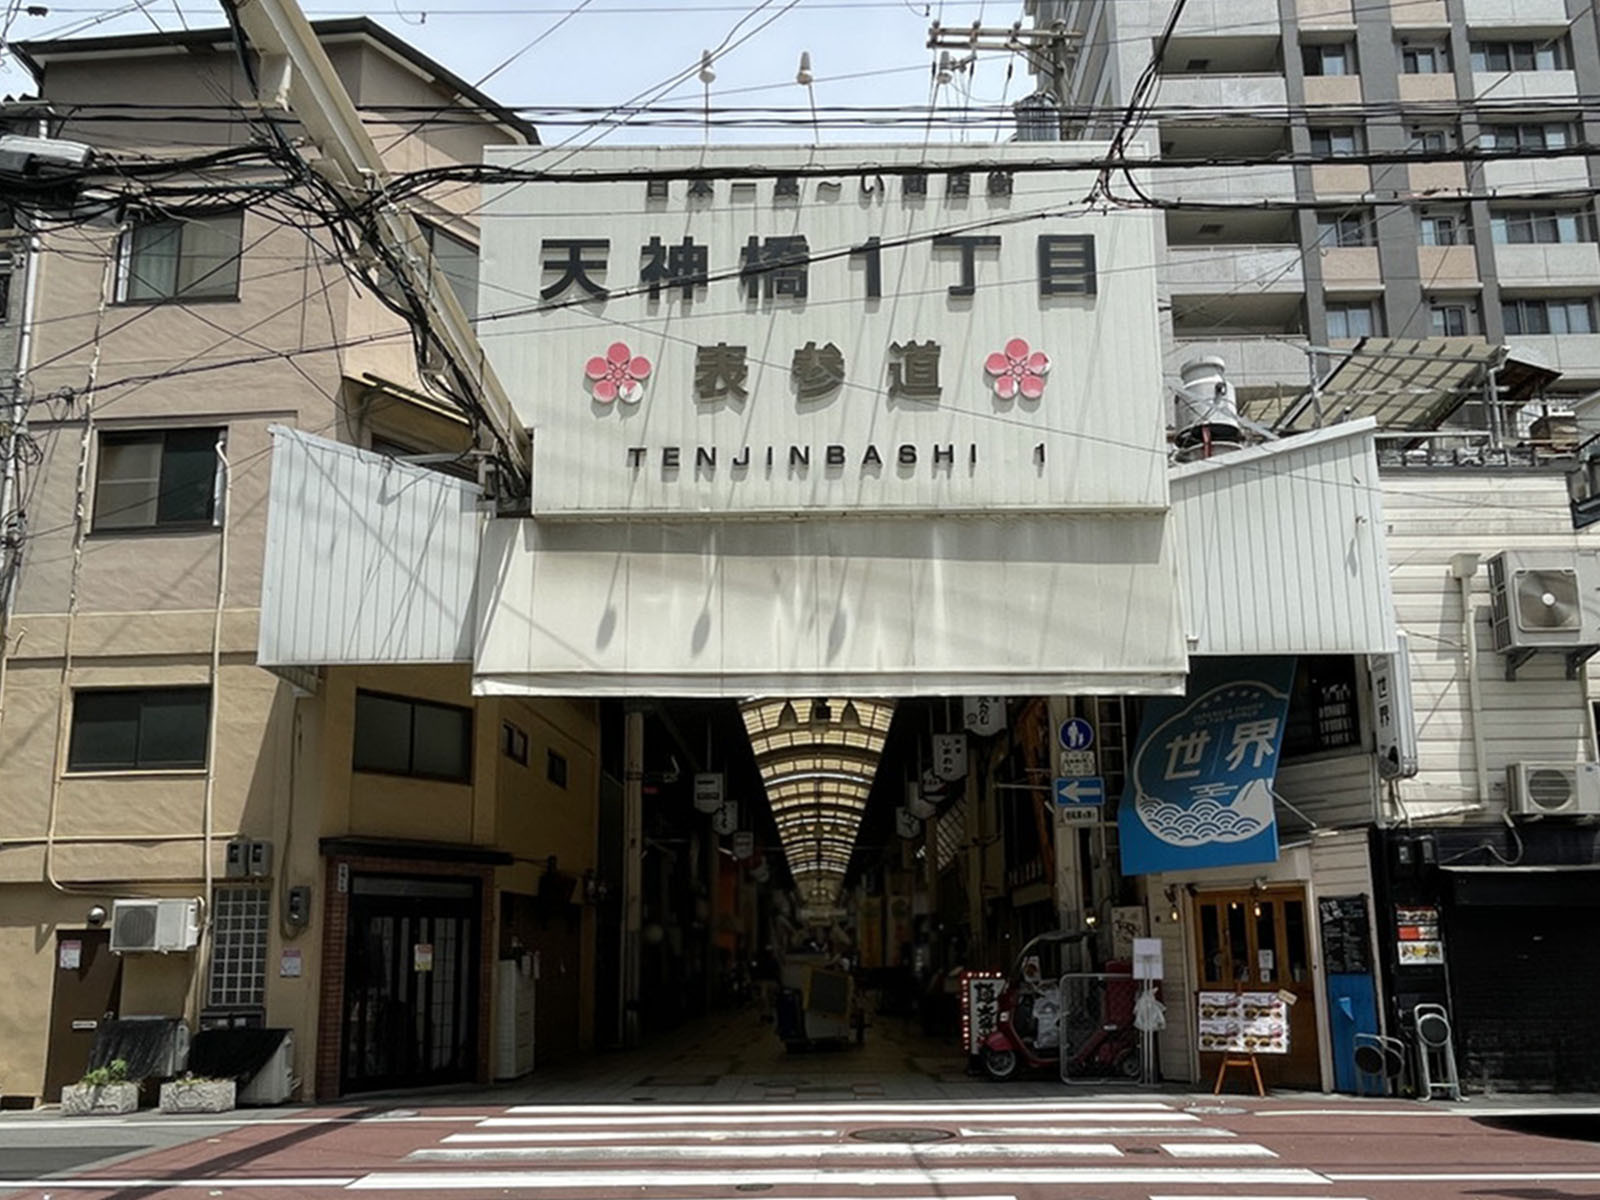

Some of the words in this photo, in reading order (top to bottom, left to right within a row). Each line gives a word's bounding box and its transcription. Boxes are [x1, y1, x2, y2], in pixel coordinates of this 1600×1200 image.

[695, 340, 943, 401] 表参道
[628, 445, 978, 467] TENJINBASHI
[1034, 442, 1048, 464] 1
[1163, 718, 1279, 780] 世界
